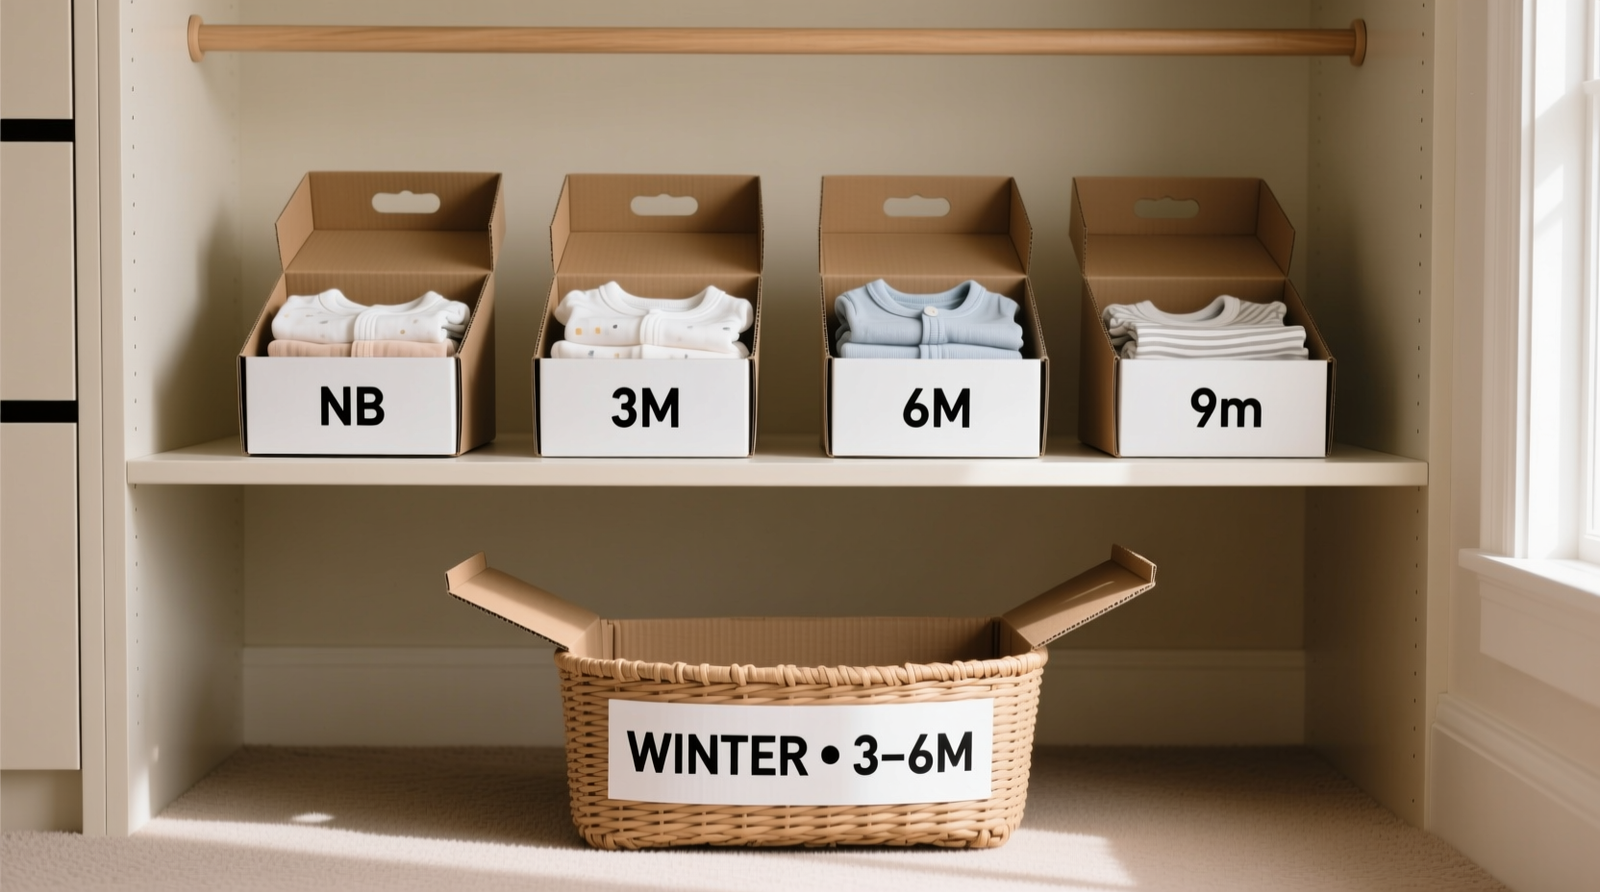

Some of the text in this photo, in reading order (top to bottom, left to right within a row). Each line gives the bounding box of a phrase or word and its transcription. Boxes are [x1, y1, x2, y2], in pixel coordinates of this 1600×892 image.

[320, 385, 385, 427] NB
[611, 386, 680, 429] 3M
[902, 387, 971, 429] 6M
[1190, 387, 1262, 428] 9m
[626, 730, 809, 777] WINTER
